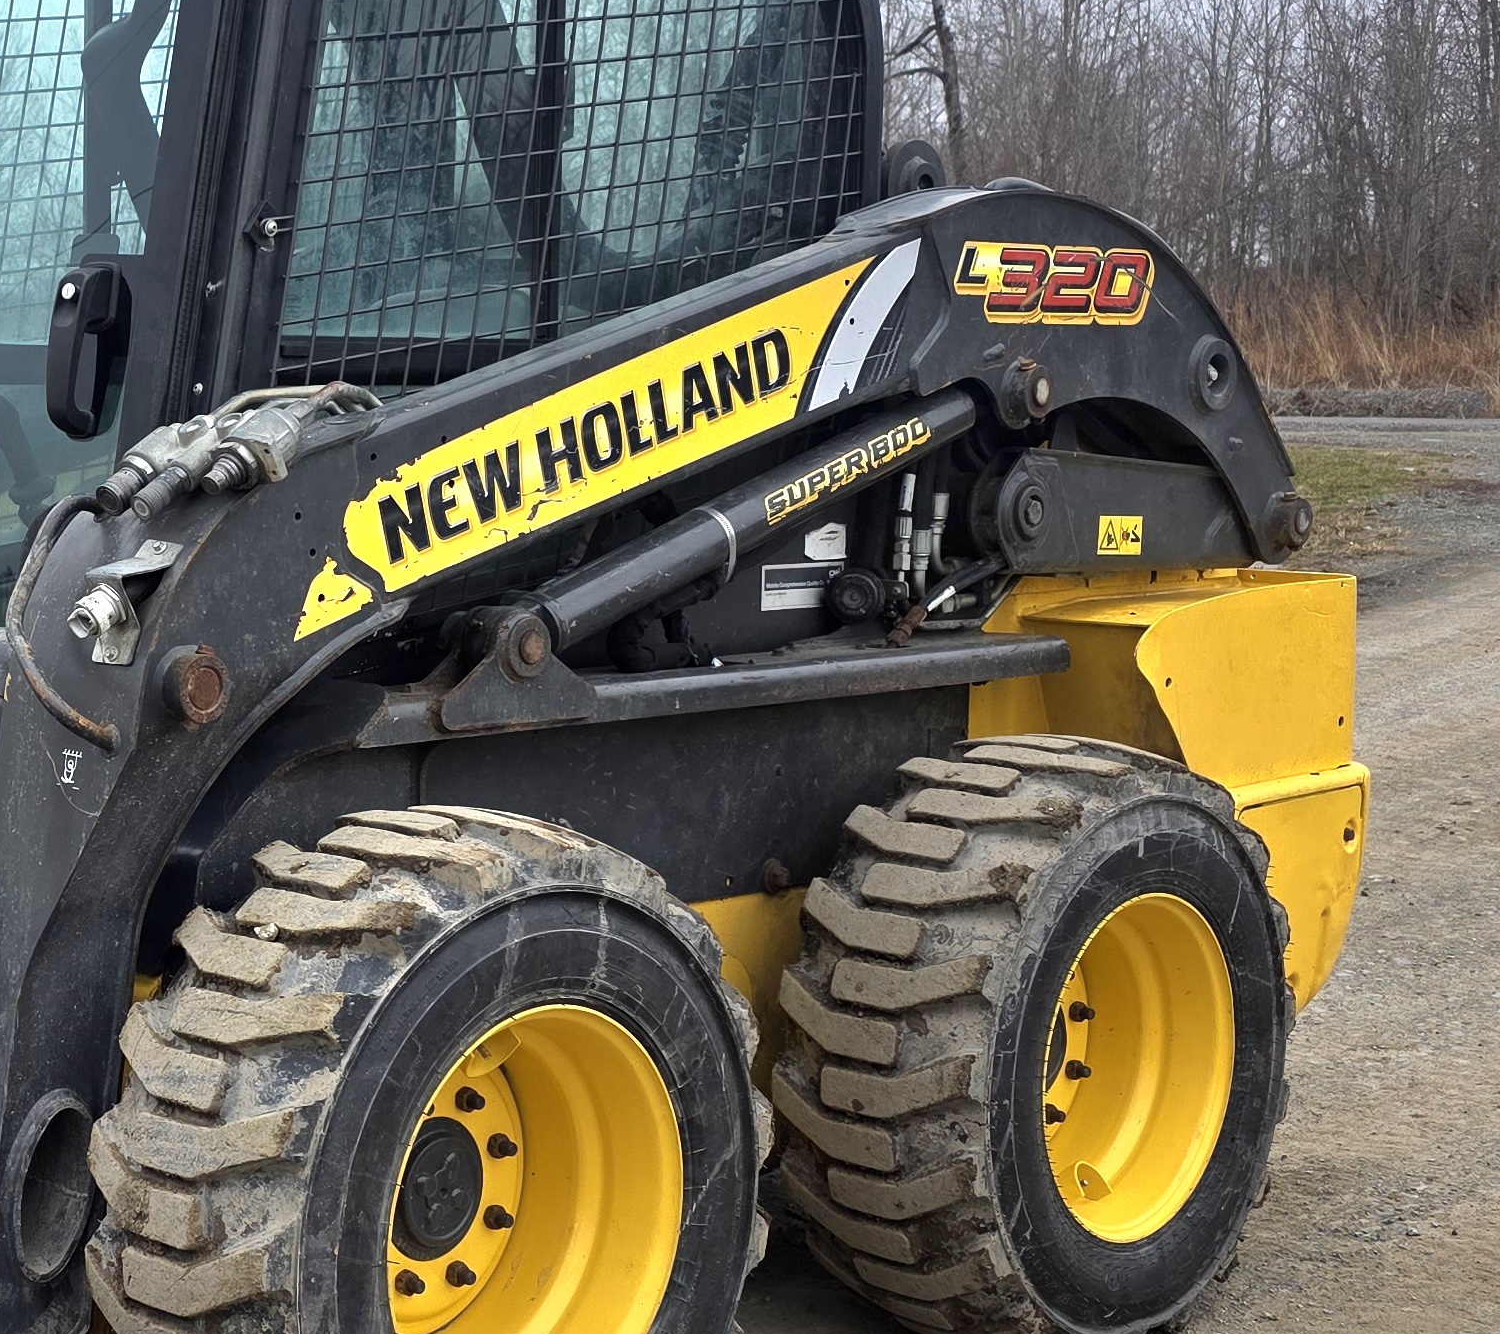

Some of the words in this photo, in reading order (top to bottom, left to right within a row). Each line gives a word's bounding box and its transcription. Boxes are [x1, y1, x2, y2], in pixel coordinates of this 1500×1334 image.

[955, 242, 1154, 323] L320
[377, 439, 524, 566] NEW
[534, 327, 792, 495] HOLLAND
[765, 448, 868, 524] SUPER
